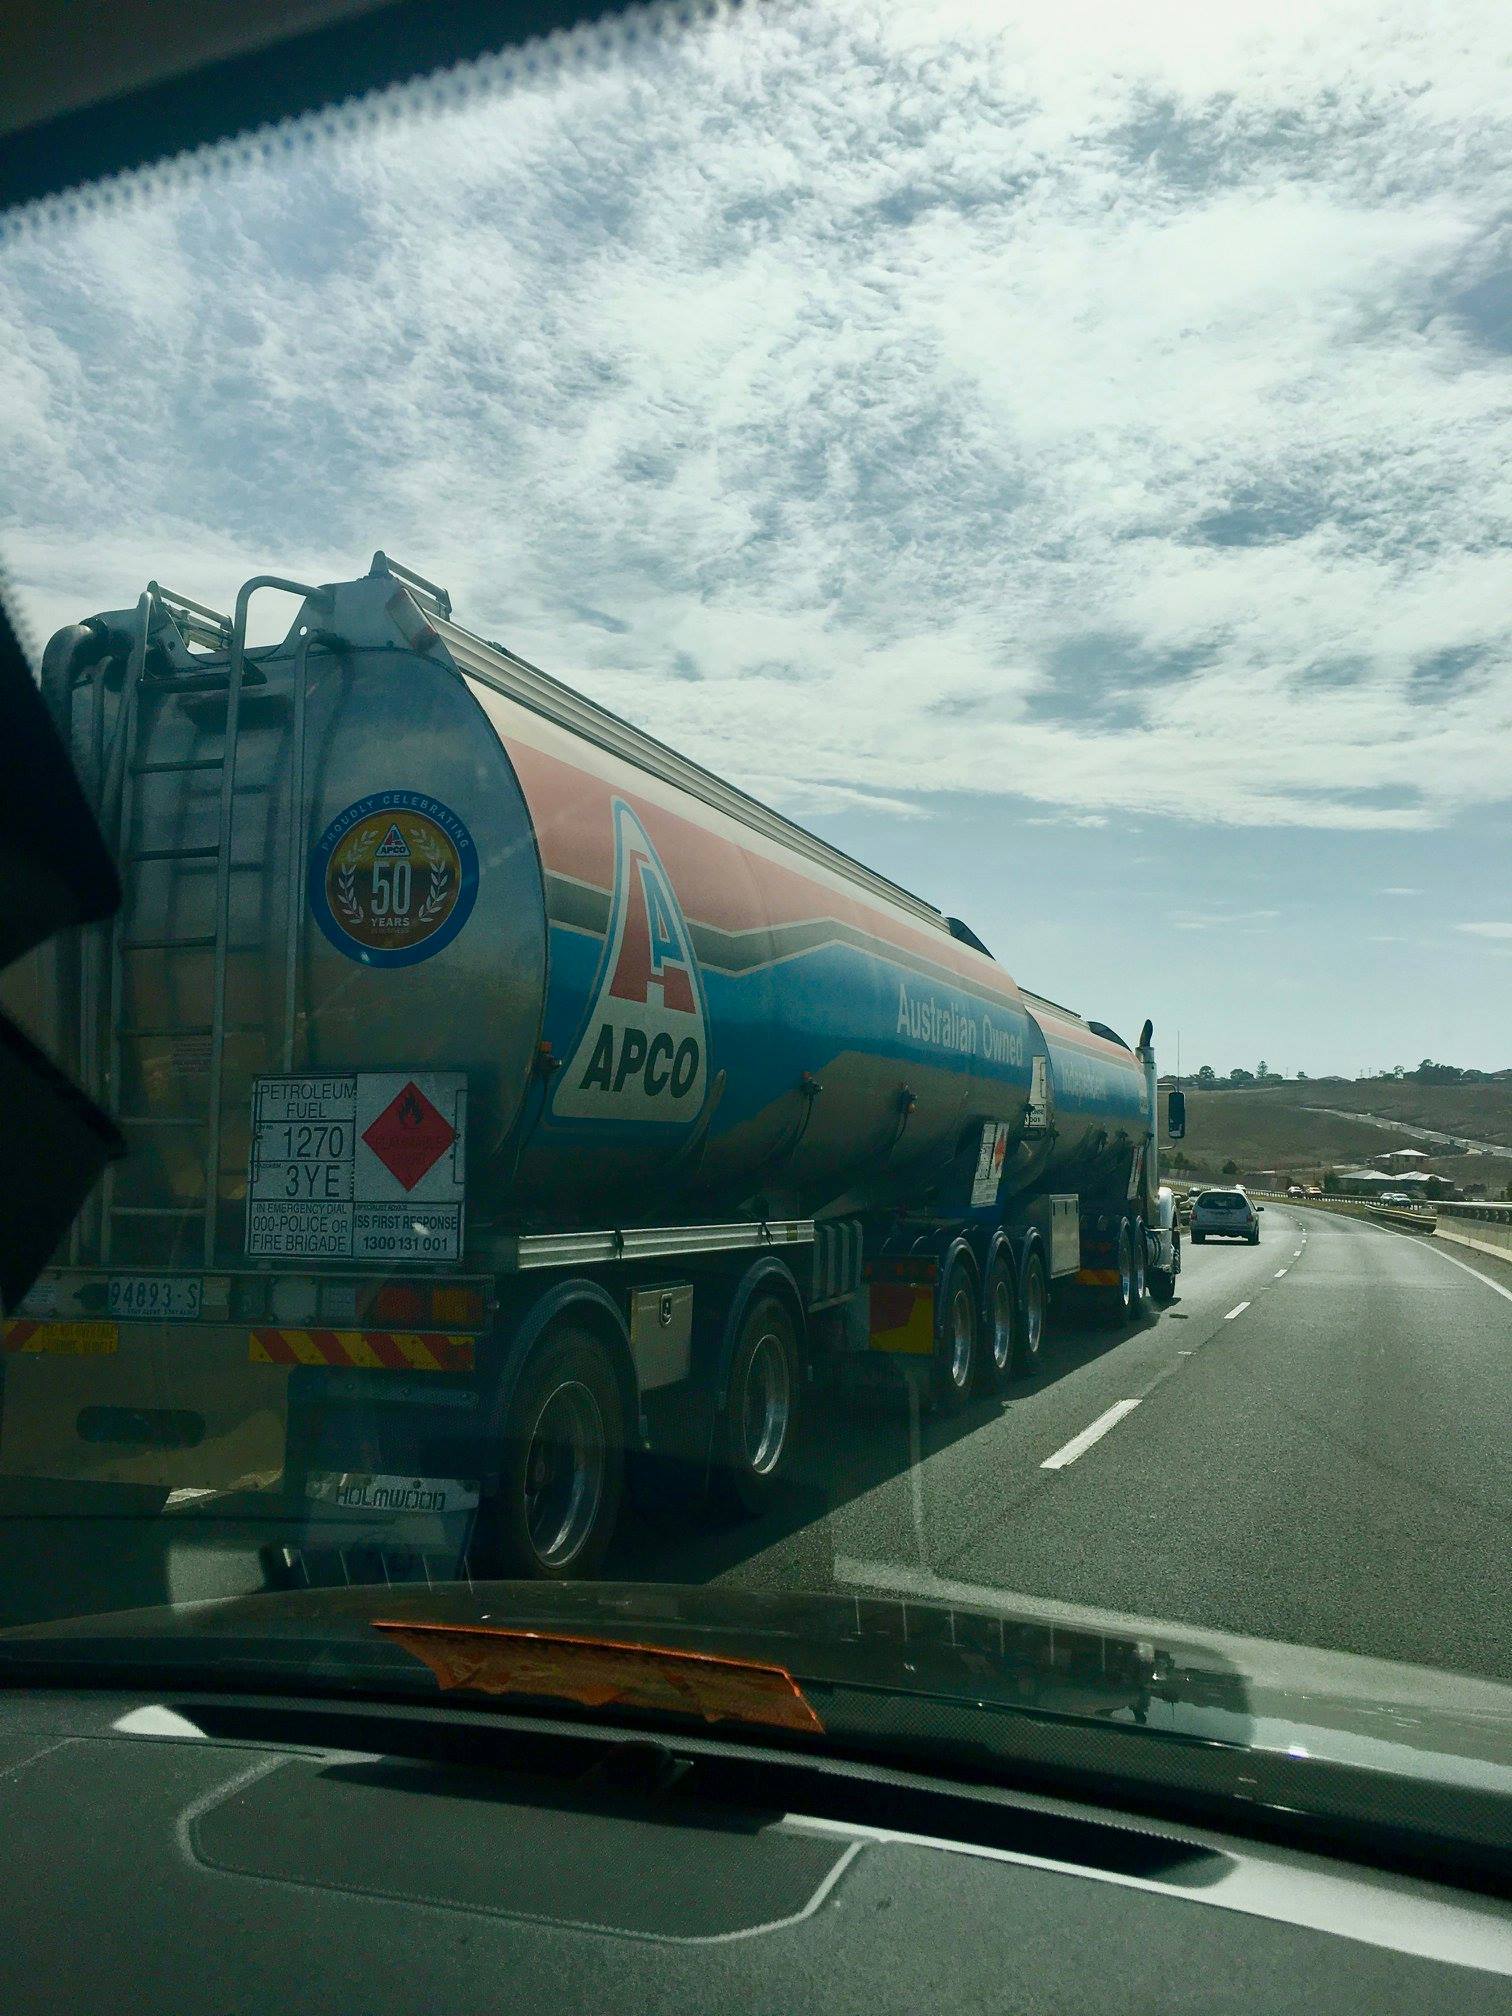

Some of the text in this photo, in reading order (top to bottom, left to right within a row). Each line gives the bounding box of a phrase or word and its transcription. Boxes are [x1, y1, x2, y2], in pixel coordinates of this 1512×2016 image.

[321, 794, 469, 851] PROUDLY CELEBRATING
[371, 861, 412, 915] 50
[371, 917, 410, 927] YEARS
[897, 984, 1023, 1066] Australian Owned
[579, 1024, 699, 1099] APCO
[260, 1083, 355, 1100] PETROLEUM
[287, 1102, 326, 1119] FUEL
[284, 1127, 343, 1158] 1270
[257, 1203, 347, 1214] IN EMERGENCY DIAL
[332, 1219, 348, 1234] OR
[354, 1215, 457, 1230] ISS FIRST RESPONSE
[252, 1234, 347, 1251] FIRE BRIGADE
[363, 1236, 448, 1250] 1300 131 001
[336, 1486, 446, 1511] HOLMWOOD
